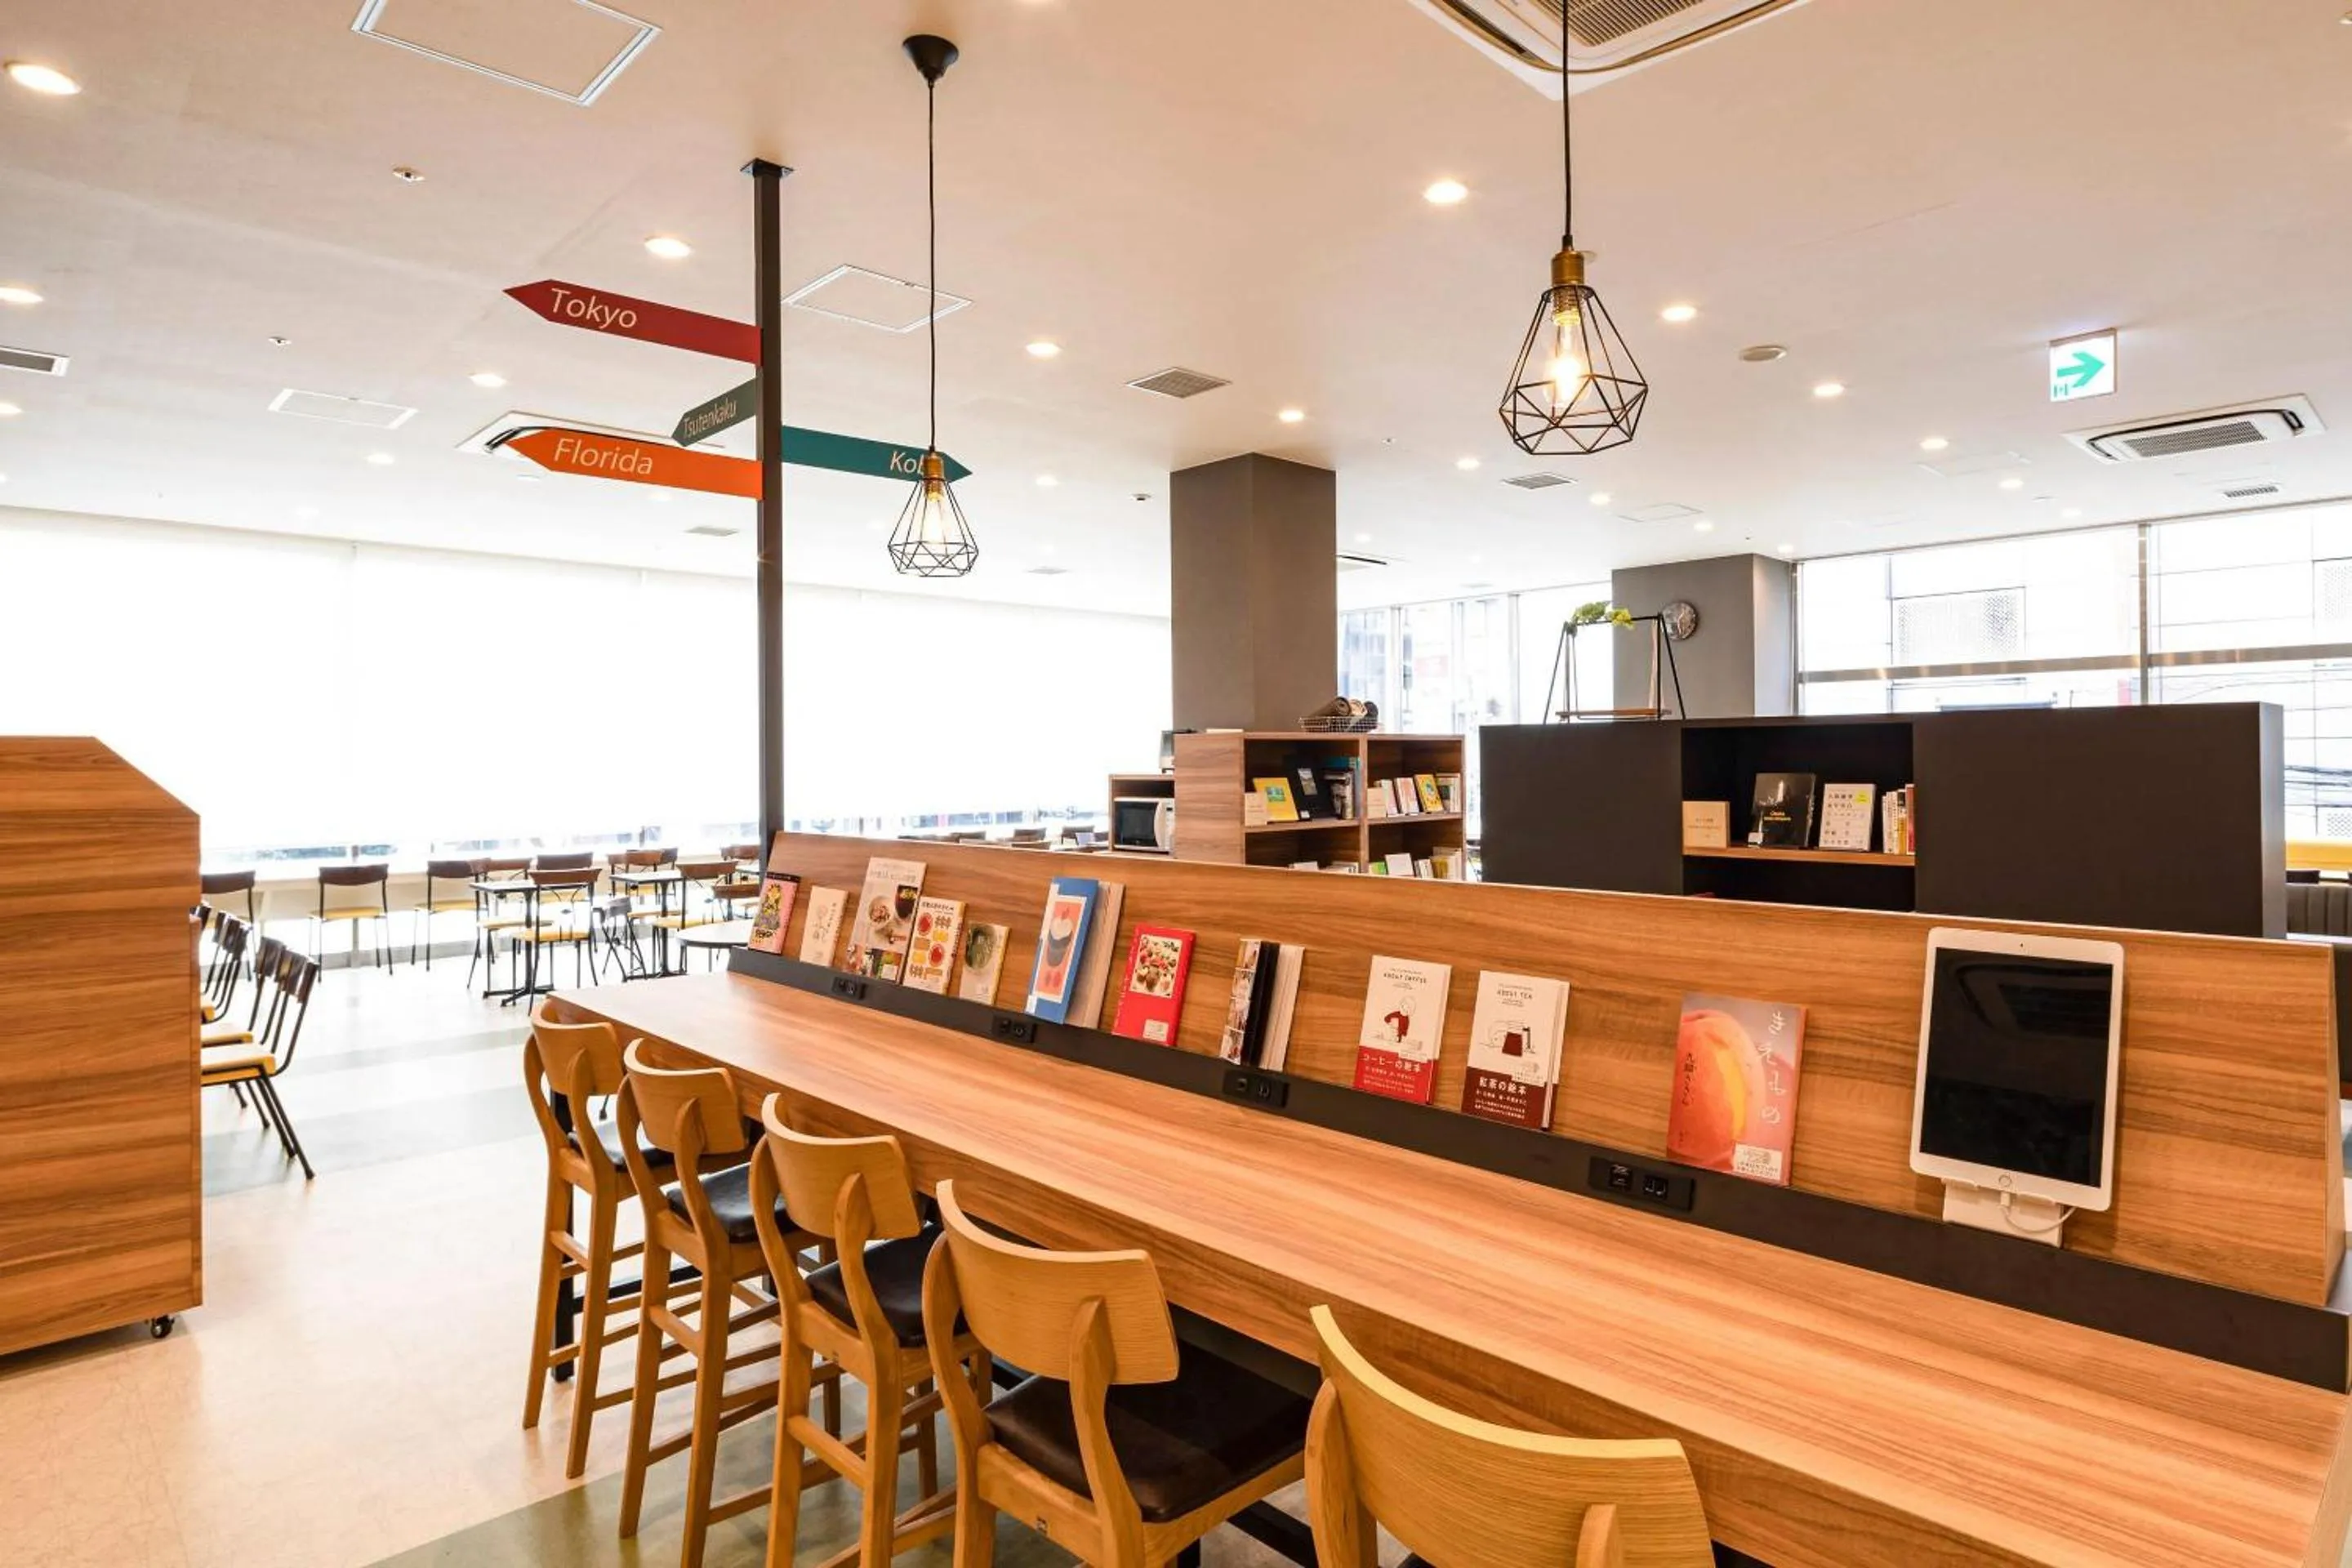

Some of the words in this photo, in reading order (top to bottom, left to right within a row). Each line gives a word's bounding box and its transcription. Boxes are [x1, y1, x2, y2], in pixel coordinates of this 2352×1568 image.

[551, 287, 637, 329] Tokyo
[683, 396, 737, 436] Tsutenkaku
[554, 438, 653, 474] Florida
[890, 451, 924, 474] Ko
[1363, 1053, 1421, 1072] コーヒーの絵本
[1479, 1076, 1526, 1095] 紅茶の絵本
